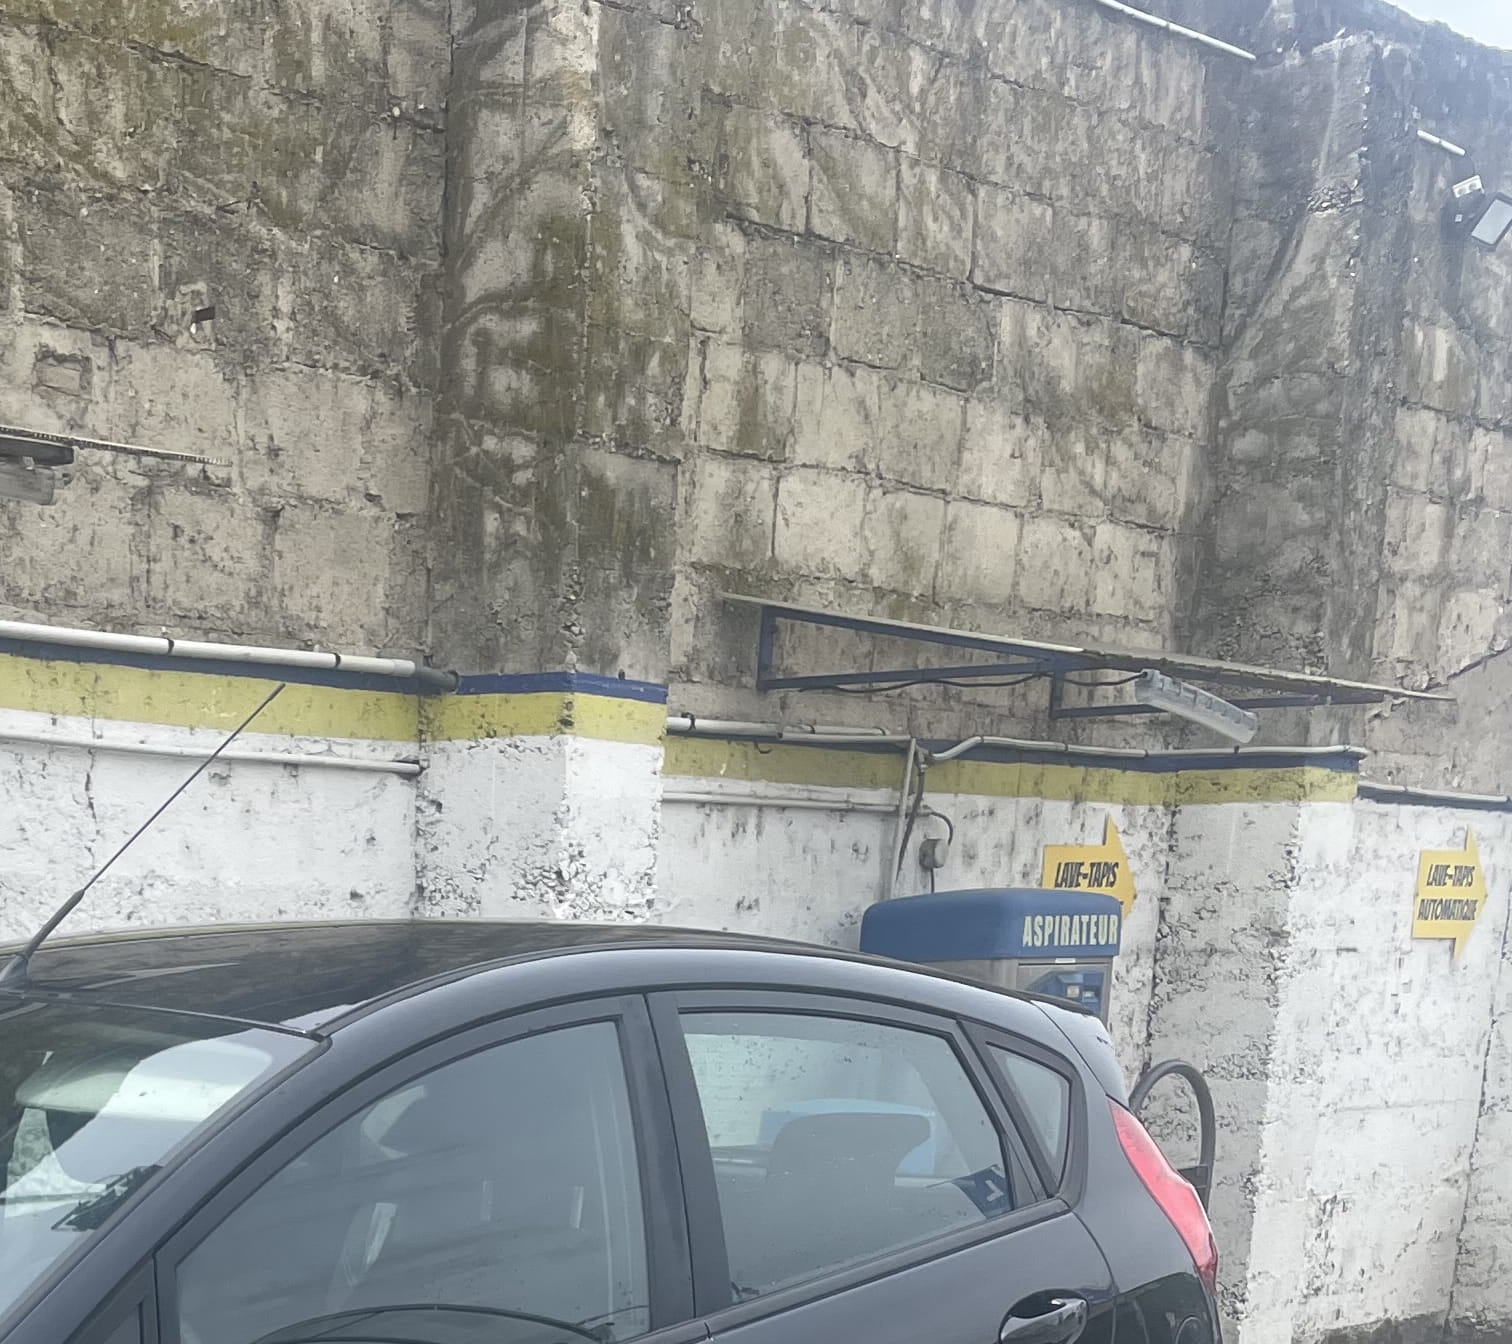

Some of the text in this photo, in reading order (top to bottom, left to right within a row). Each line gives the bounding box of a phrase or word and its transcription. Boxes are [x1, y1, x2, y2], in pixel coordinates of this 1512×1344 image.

[1054, 861, 1119, 888] LAVE-TAPIS
[1426, 863, 1476, 887] LAVE-TAPIS
[1416, 897, 1479, 921] AUTOMATIQUE
[1021, 914, 1119, 947] ASPIRATEUR
